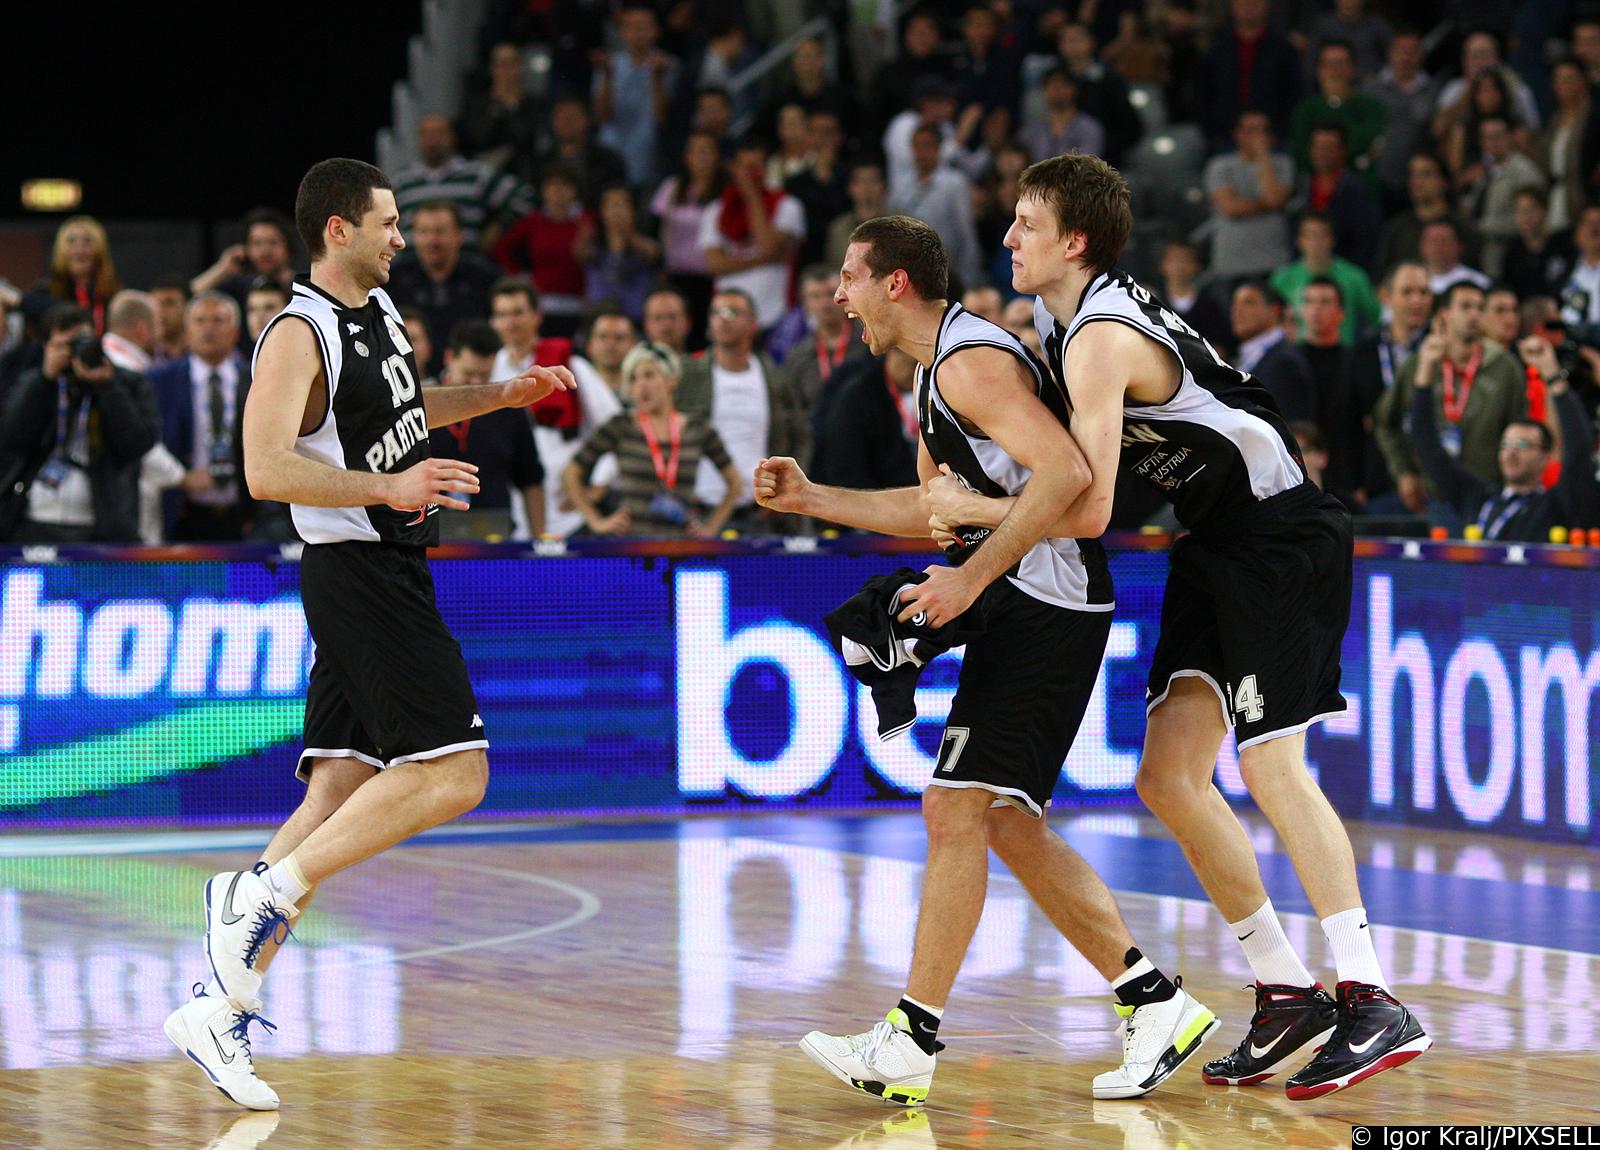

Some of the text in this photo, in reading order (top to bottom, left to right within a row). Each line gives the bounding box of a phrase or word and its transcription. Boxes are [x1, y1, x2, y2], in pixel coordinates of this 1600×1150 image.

[381, 354, 416, 408] 10
[0, 568, 317, 697] hom
[1226, 674, 1265, 727] 4
[937, 726, 970, 773] 7
